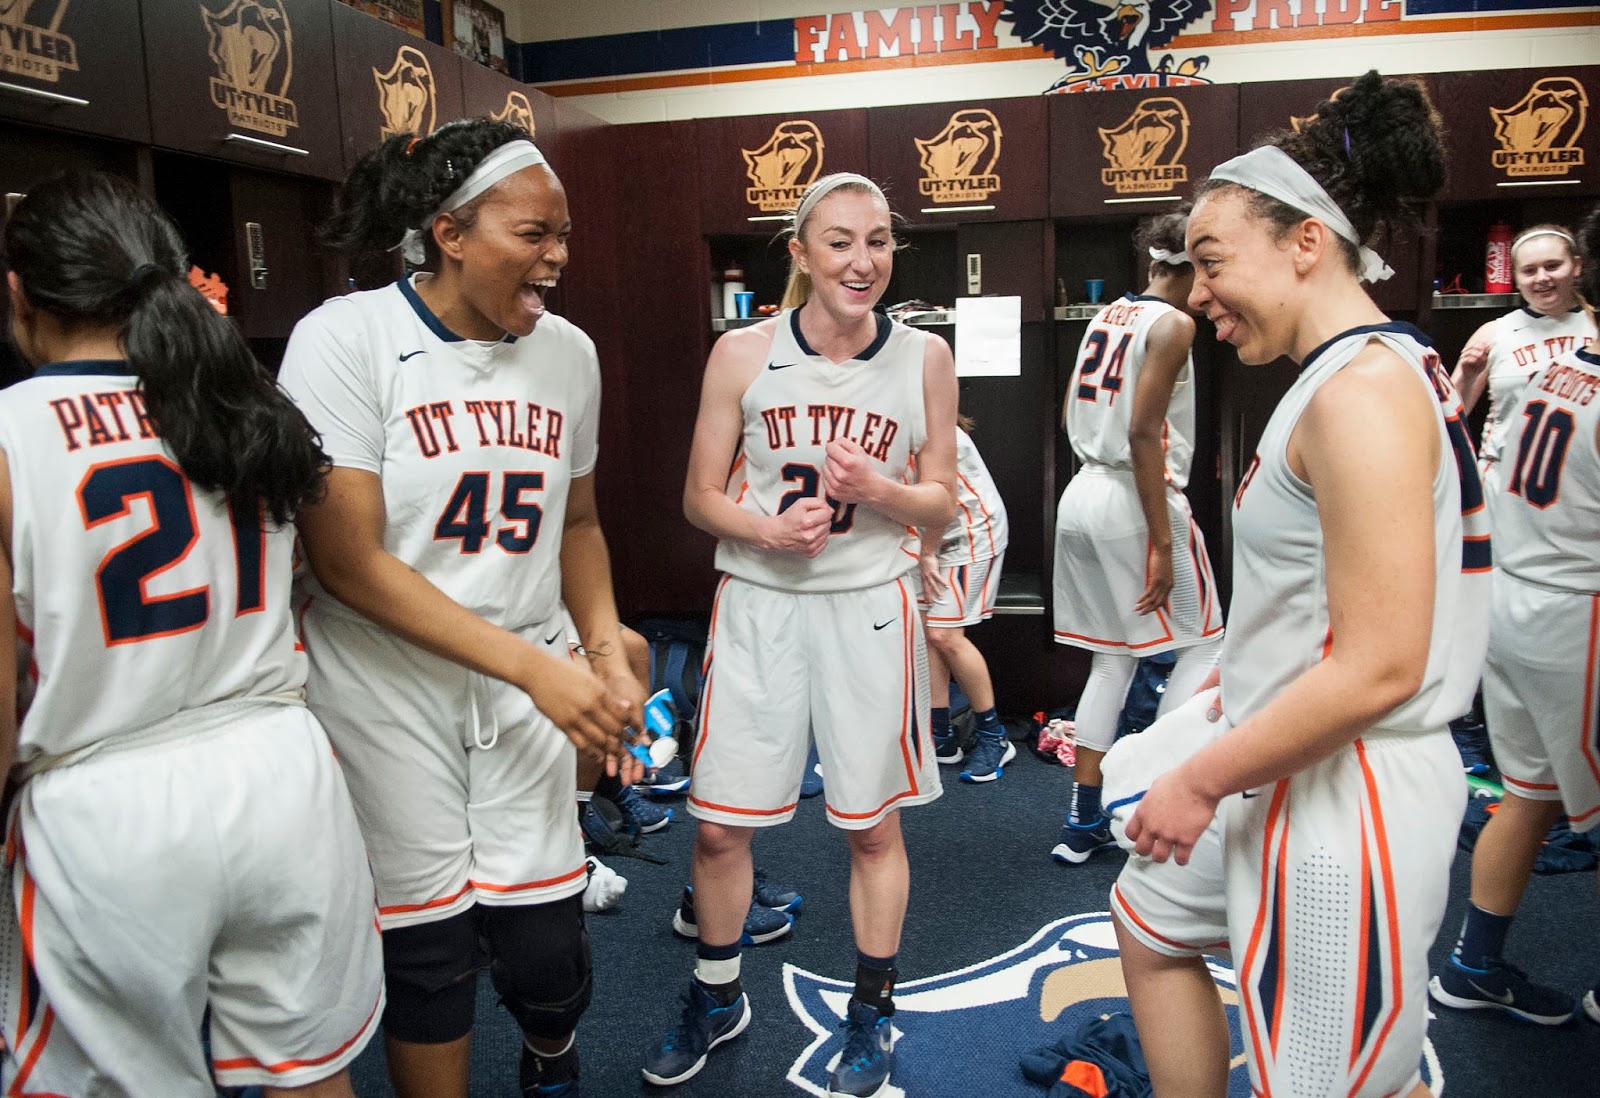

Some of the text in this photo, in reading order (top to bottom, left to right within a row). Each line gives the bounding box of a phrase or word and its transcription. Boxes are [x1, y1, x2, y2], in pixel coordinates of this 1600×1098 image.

[794, 0, 1005, 63] FAMILY
[1212, 0, 1400, 32] PRIDE
[1511, 165, 1565, 173] PATRIOTS
[1077, 328, 1135, 407] 24
[1513, 343, 1539, 367] UT
[404, 399, 564, 460] UT TYLER
[761, 404, 899, 463] UT TYLER
[1507, 399, 1576, 511] 10
[433, 471, 545, 555] 45
[75, 453, 266, 648] 21
